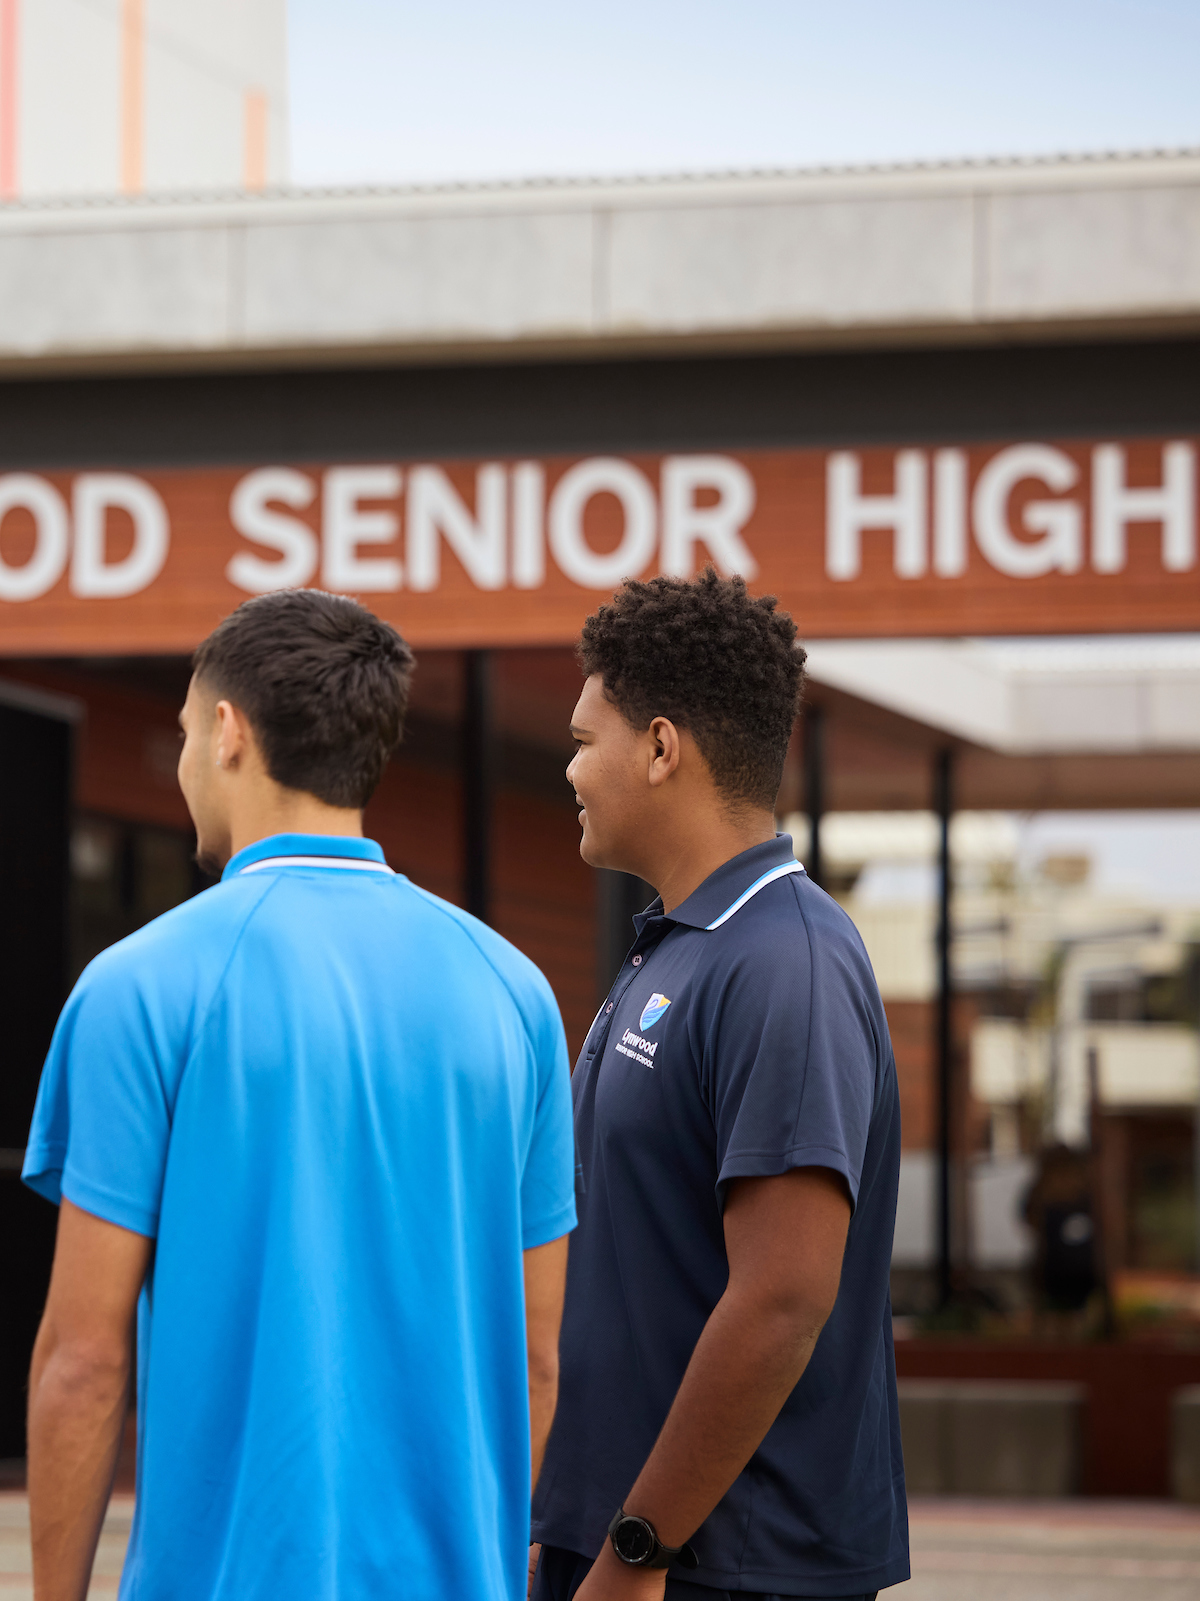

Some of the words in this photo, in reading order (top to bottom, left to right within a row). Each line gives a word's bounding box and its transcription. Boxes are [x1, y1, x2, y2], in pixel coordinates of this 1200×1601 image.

[227, 454, 757, 594] SENIOR
[826, 440, 1195, 580] HIGH
[622, 1028, 658, 1057] Lynwood
